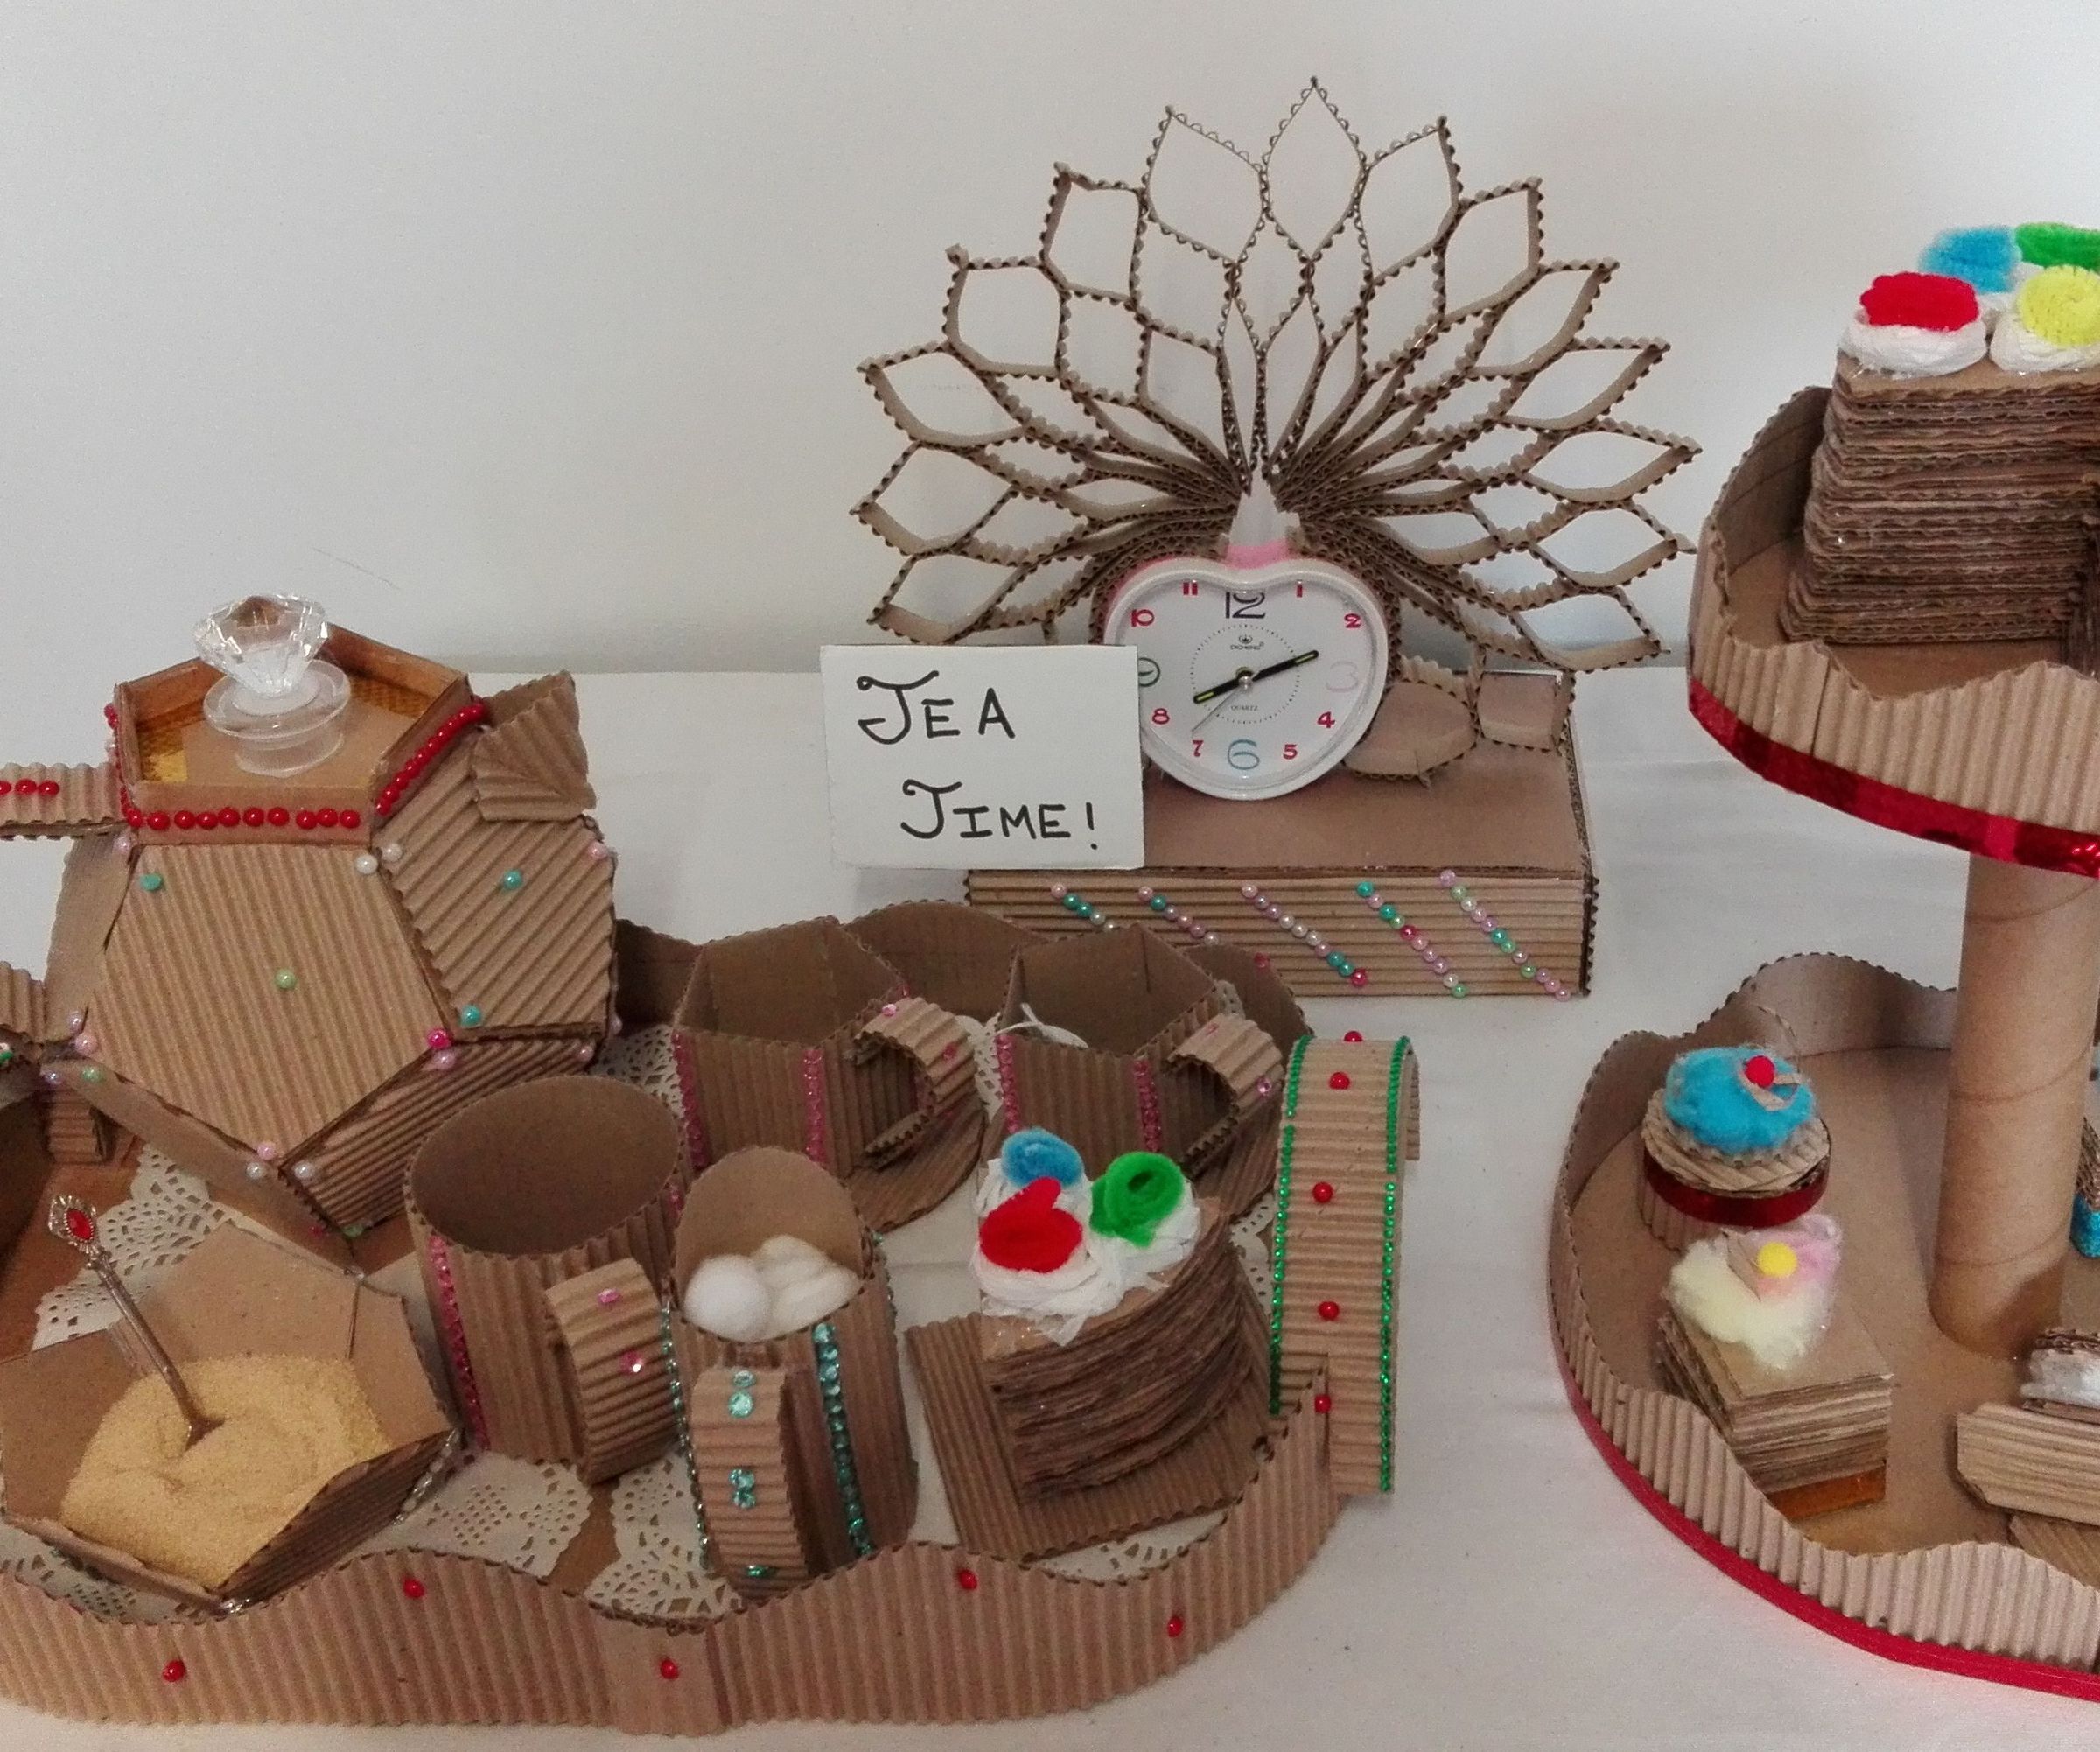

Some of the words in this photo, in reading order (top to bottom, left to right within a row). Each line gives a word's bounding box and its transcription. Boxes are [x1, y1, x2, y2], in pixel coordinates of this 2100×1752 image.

[1182, 581, 1199, 596] 11
[1225, 591, 1266, 620] 12
[1130, 609, 1155, 627] 10
[1344, 613, 1362, 629] 2
[1325, 661, 1360, 693] 3
[1152, 708, 1171, 725] 8
[1317, 711, 1336, 729] 4
[1192, 739, 1204, 757] 7
[1227, 739, 1260, 771] 6
[1283, 744, 1298, 760] 5
